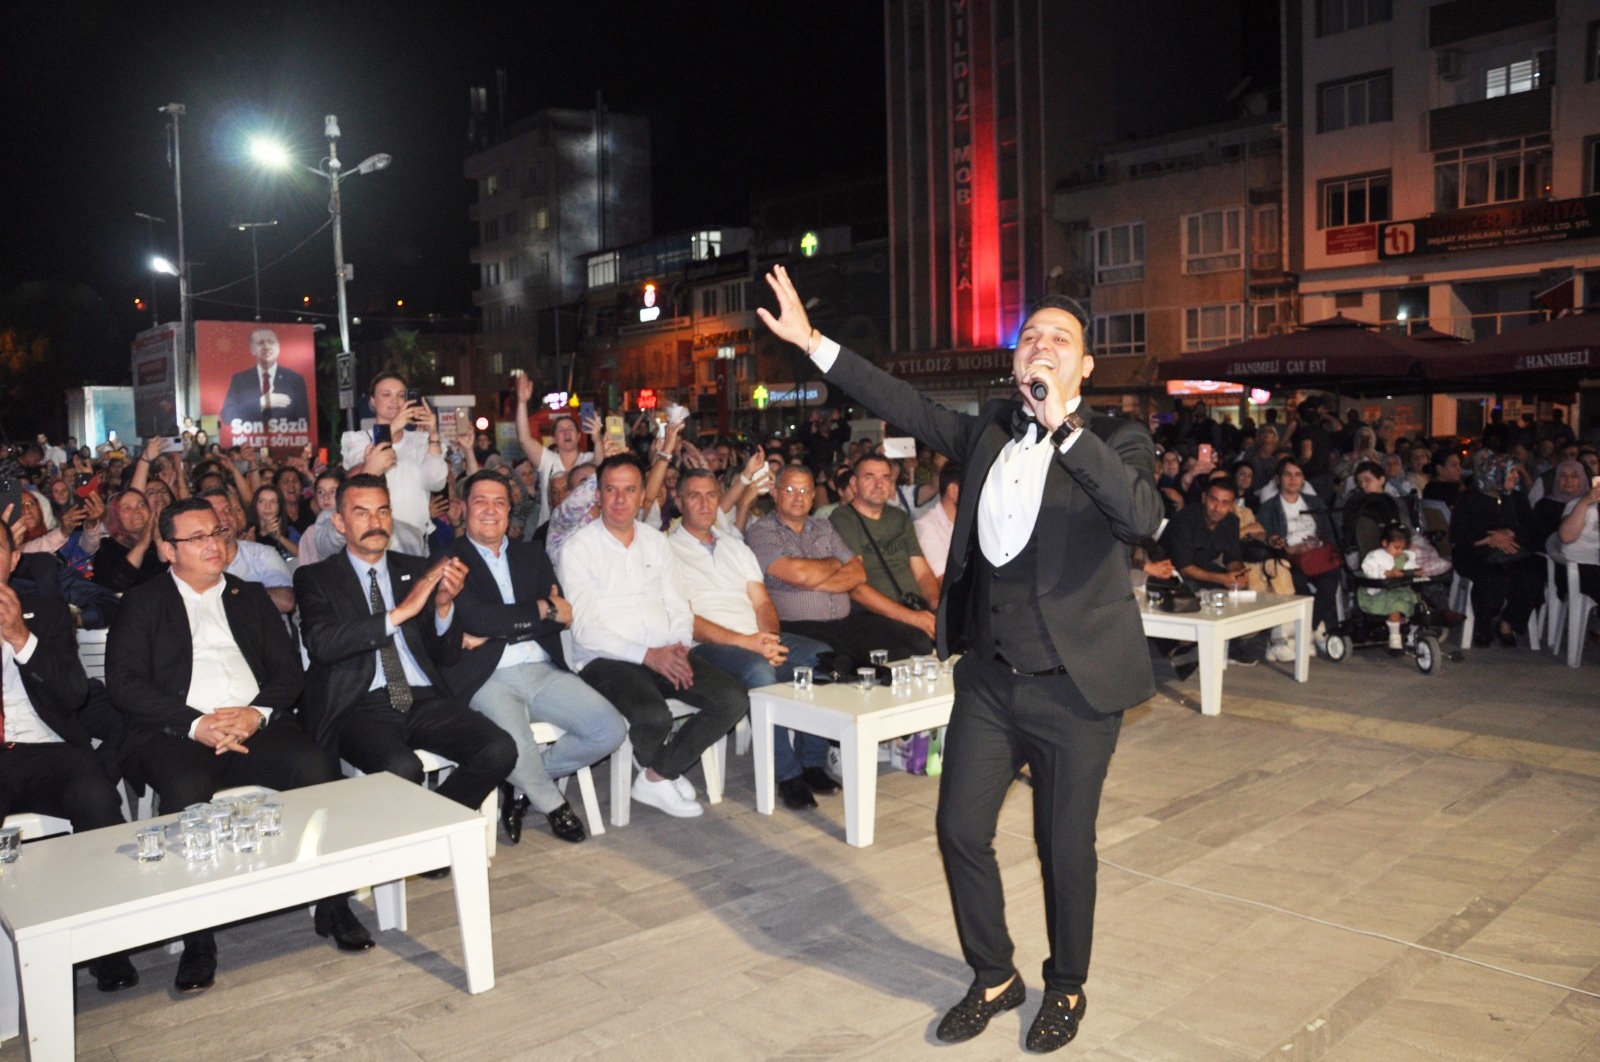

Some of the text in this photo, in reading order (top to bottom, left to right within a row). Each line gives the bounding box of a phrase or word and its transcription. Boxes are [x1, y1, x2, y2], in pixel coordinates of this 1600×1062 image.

[898, 357, 951, 374] YILDIZ
[958, 351, 1014, 370] MOBİL
[1525, 347, 1590, 369] HANIMELİ
[230, 417, 308, 435] Son Sözü
